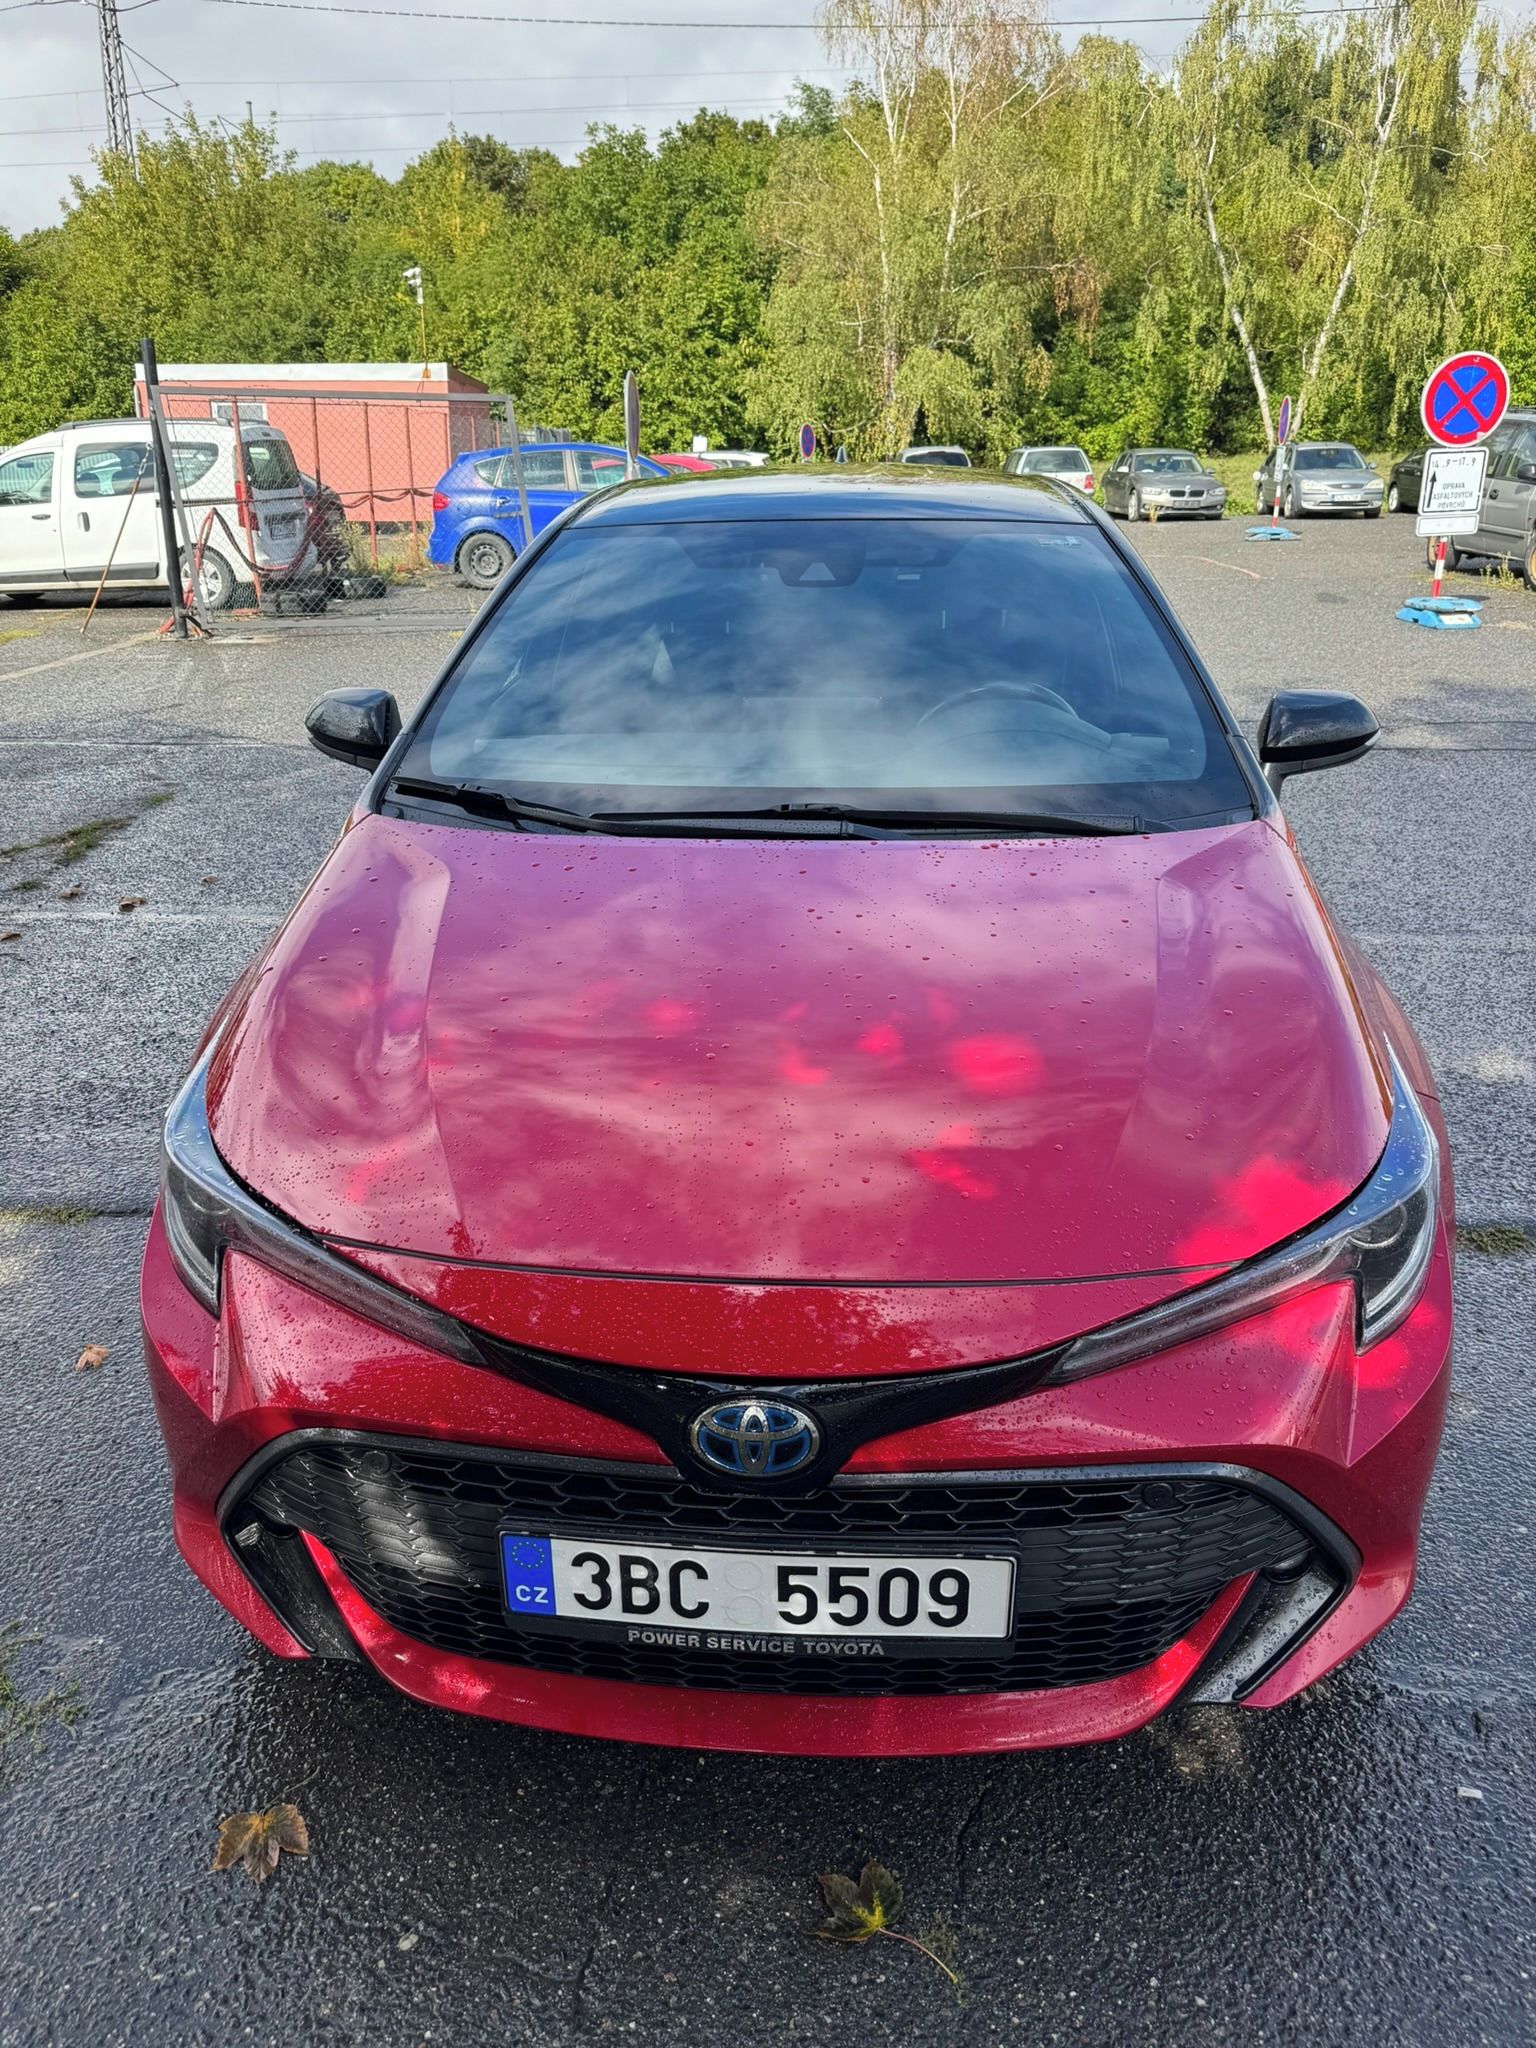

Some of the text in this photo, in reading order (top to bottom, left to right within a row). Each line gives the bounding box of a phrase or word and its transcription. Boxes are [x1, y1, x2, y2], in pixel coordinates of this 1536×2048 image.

[1443, 482, 1465, 490] OPRAVA
[515, 1585, 549, 1604] CZ
[571, 1552, 970, 1627] 3BC 5509
[627, 1629, 885, 1656] POWER SERVICE TOYOTA
